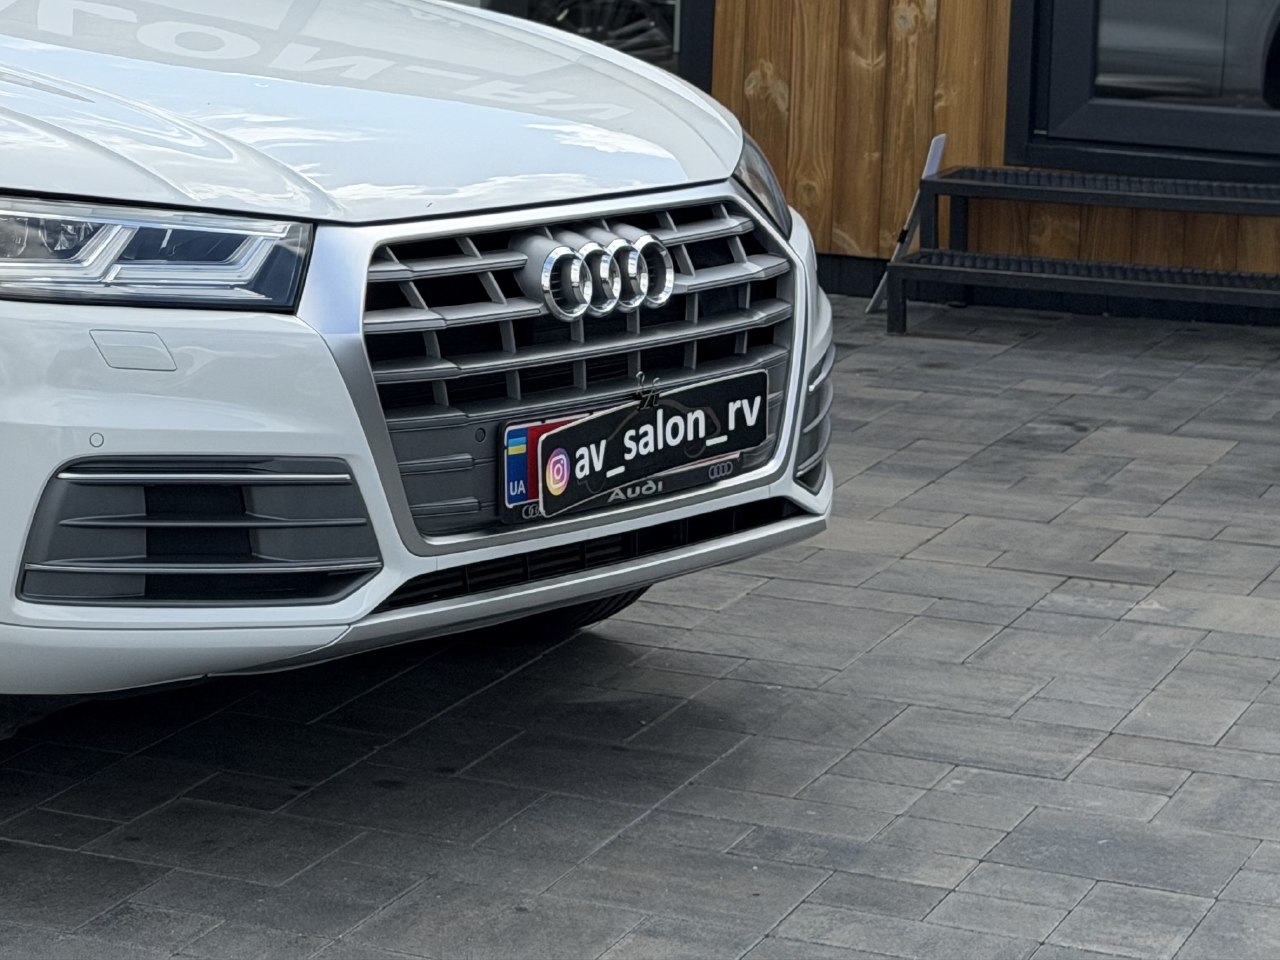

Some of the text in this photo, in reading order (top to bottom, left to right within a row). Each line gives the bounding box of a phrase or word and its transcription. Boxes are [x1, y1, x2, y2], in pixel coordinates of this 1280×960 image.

[574, 394, 761, 479] av_salon_rv
[509, 481, 526, 496] UA
[607, 480, 663, 503] Audi
